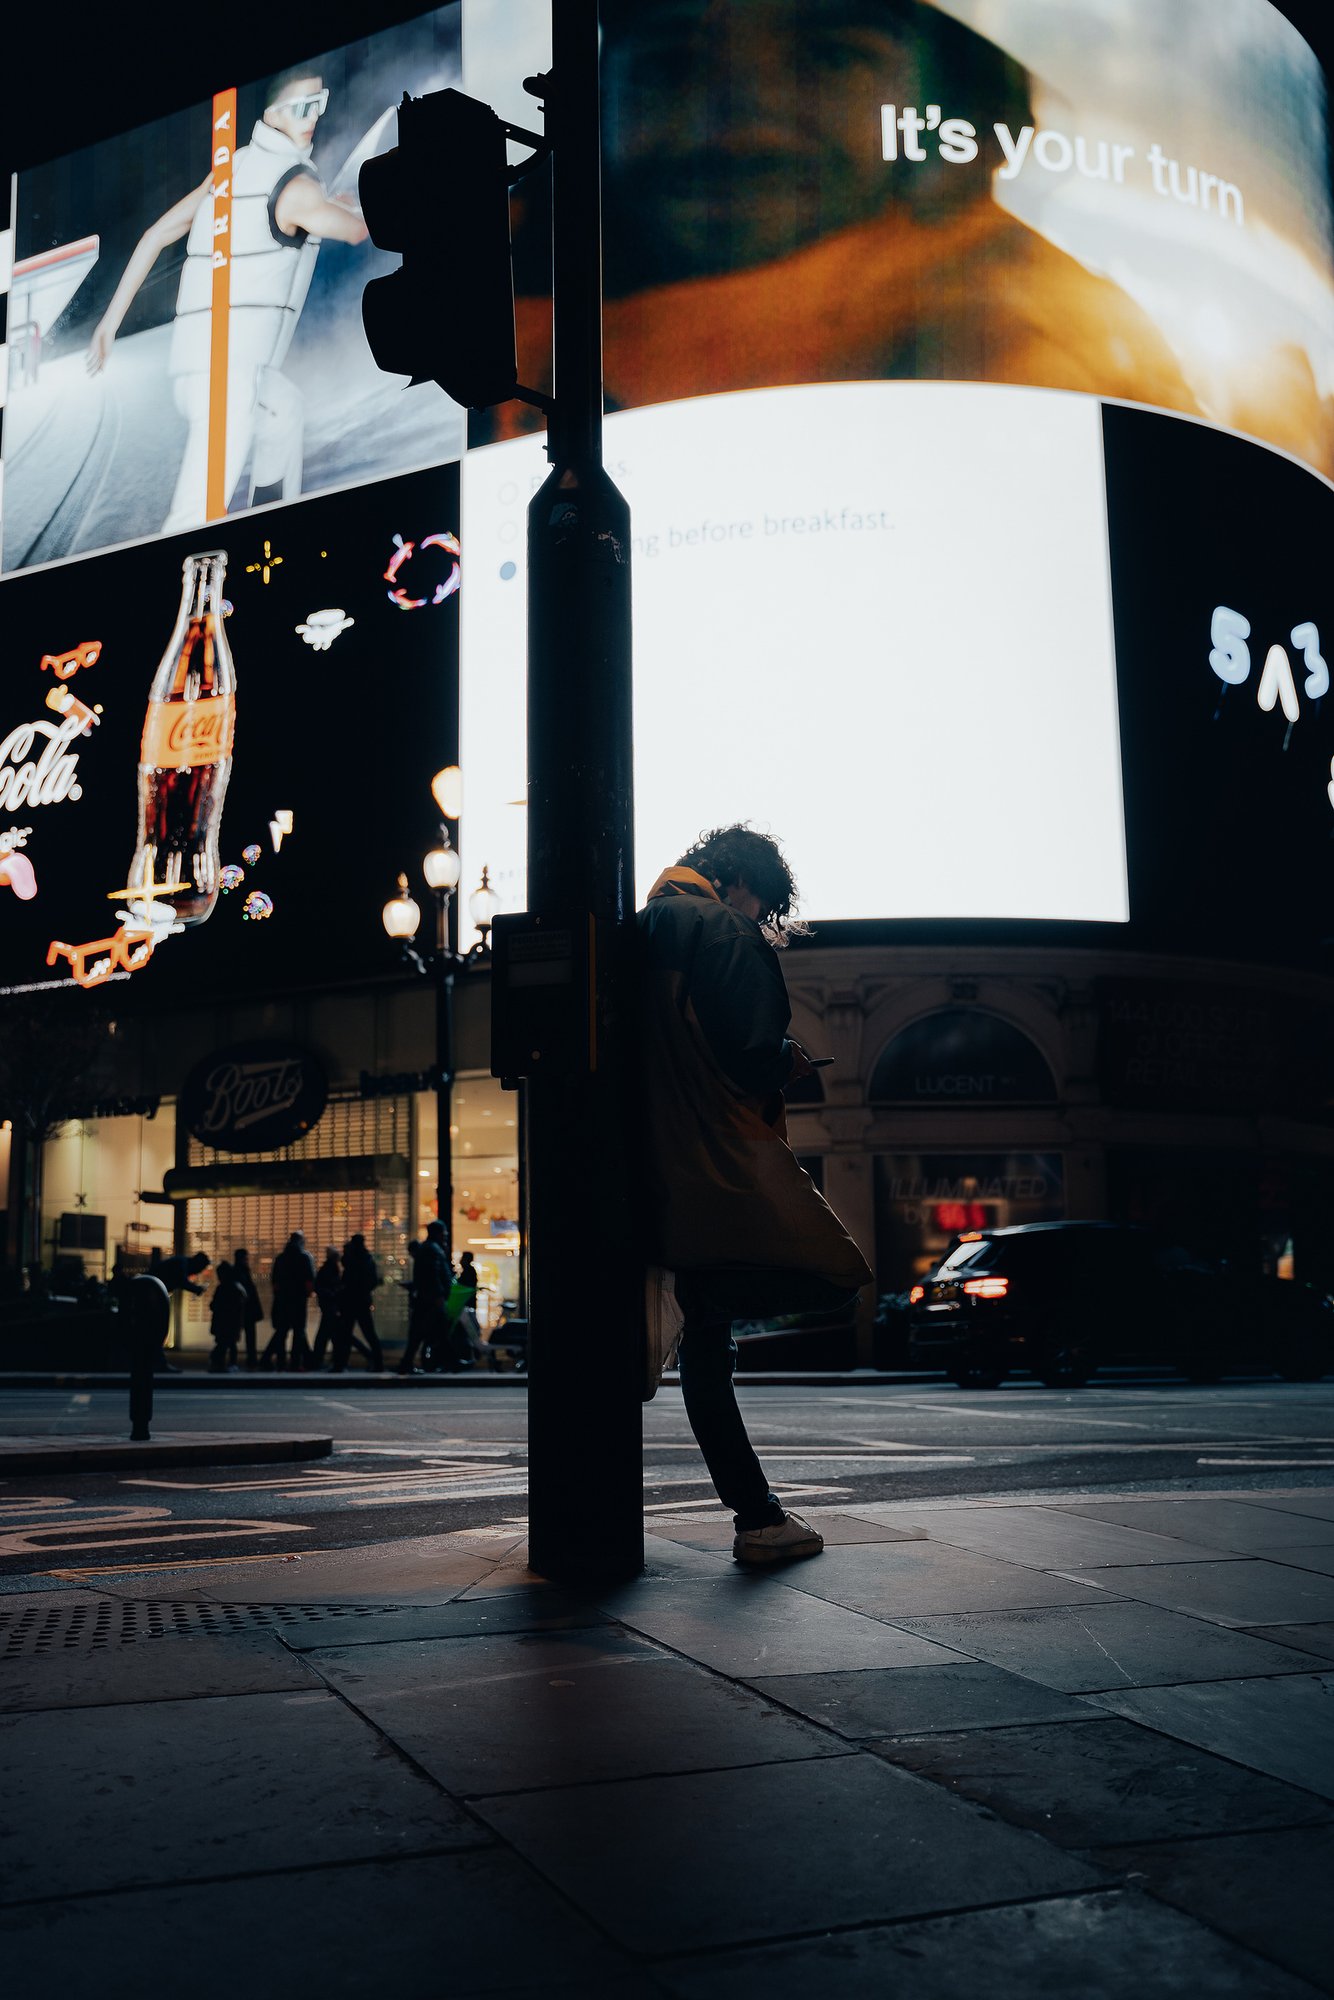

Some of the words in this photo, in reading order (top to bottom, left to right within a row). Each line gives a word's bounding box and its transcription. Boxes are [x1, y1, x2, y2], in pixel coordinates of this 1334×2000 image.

[212, 109, 232, 270] PRADA
[880, 104, 979, 164] It's
[993, 122, 1134, 181] your
[1147, 143, 1245, 226] turn
[667, 518, 755, 549] before
[762, 505, 897, 537] breakfast.
[203, 1058, 304, 1131] Boots
[915, 1074, 996, 1094] LUCENT
[888, 1176, 1048, 1199] ILLUMINATED
